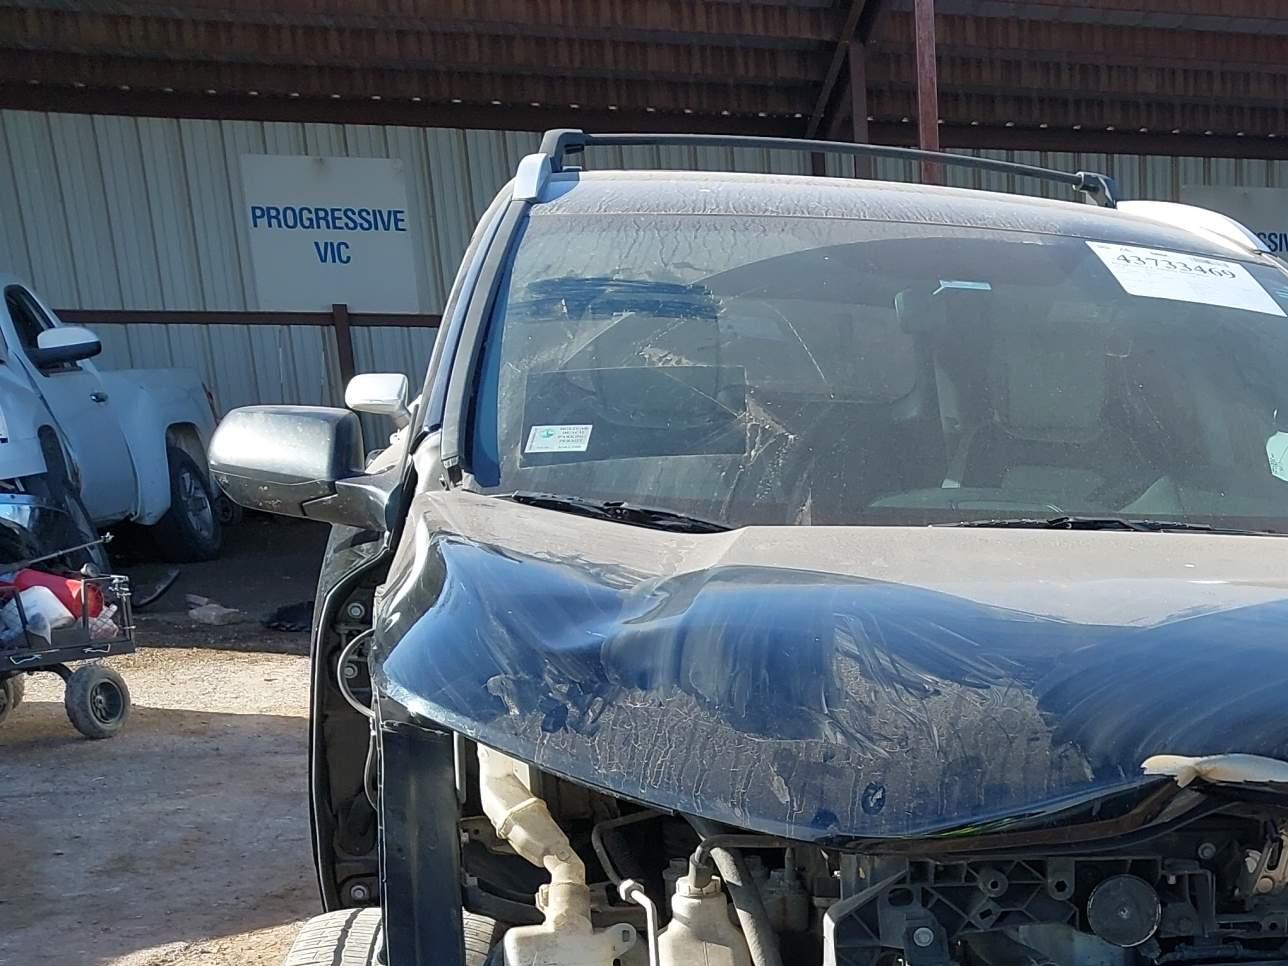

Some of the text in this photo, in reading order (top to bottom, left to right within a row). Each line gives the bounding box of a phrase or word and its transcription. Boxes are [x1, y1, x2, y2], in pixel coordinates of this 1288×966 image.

[250, 206, 407, 232] PROGRESSIVE
[314, 241, 351, 264] VIC
[1116, 253, 1236, 279] 43733469
